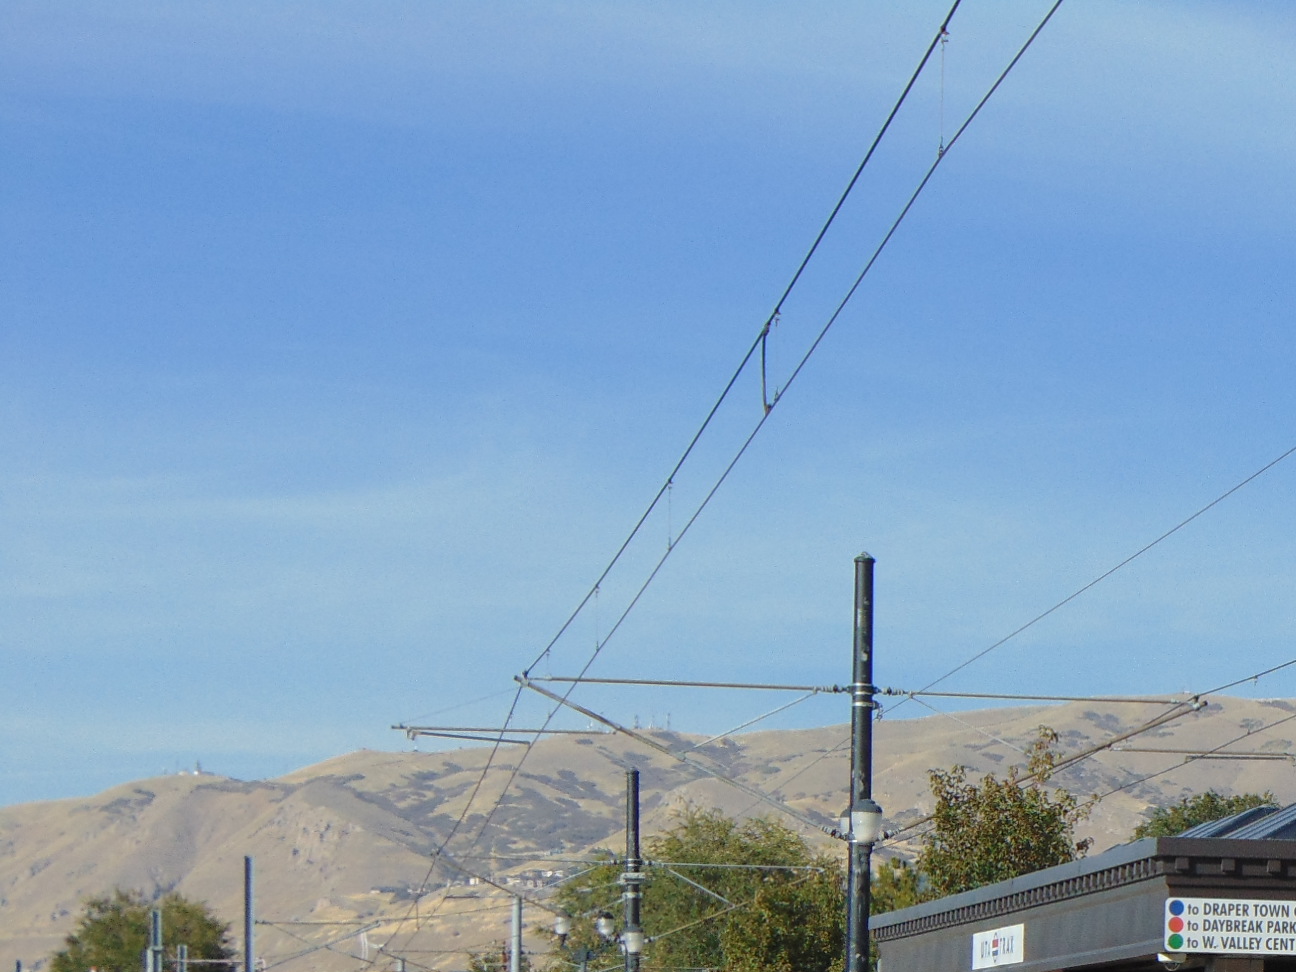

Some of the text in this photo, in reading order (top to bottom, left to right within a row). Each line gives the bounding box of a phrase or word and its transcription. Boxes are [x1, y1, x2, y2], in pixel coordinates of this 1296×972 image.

[1187, 903, 1199, 916] to
[1203, 902, 1250, 916] DRAPER
[1253, 904, 1290, 918] TOWN
[1186, 920, 1199, 932] to
[1202, 919, 1263, 933] DAYBREAK
[1186, 936, 1199, 948] to
[1202, 935, 1218, 949] W.
[1220, 936, 1262, 951] VALLEY
